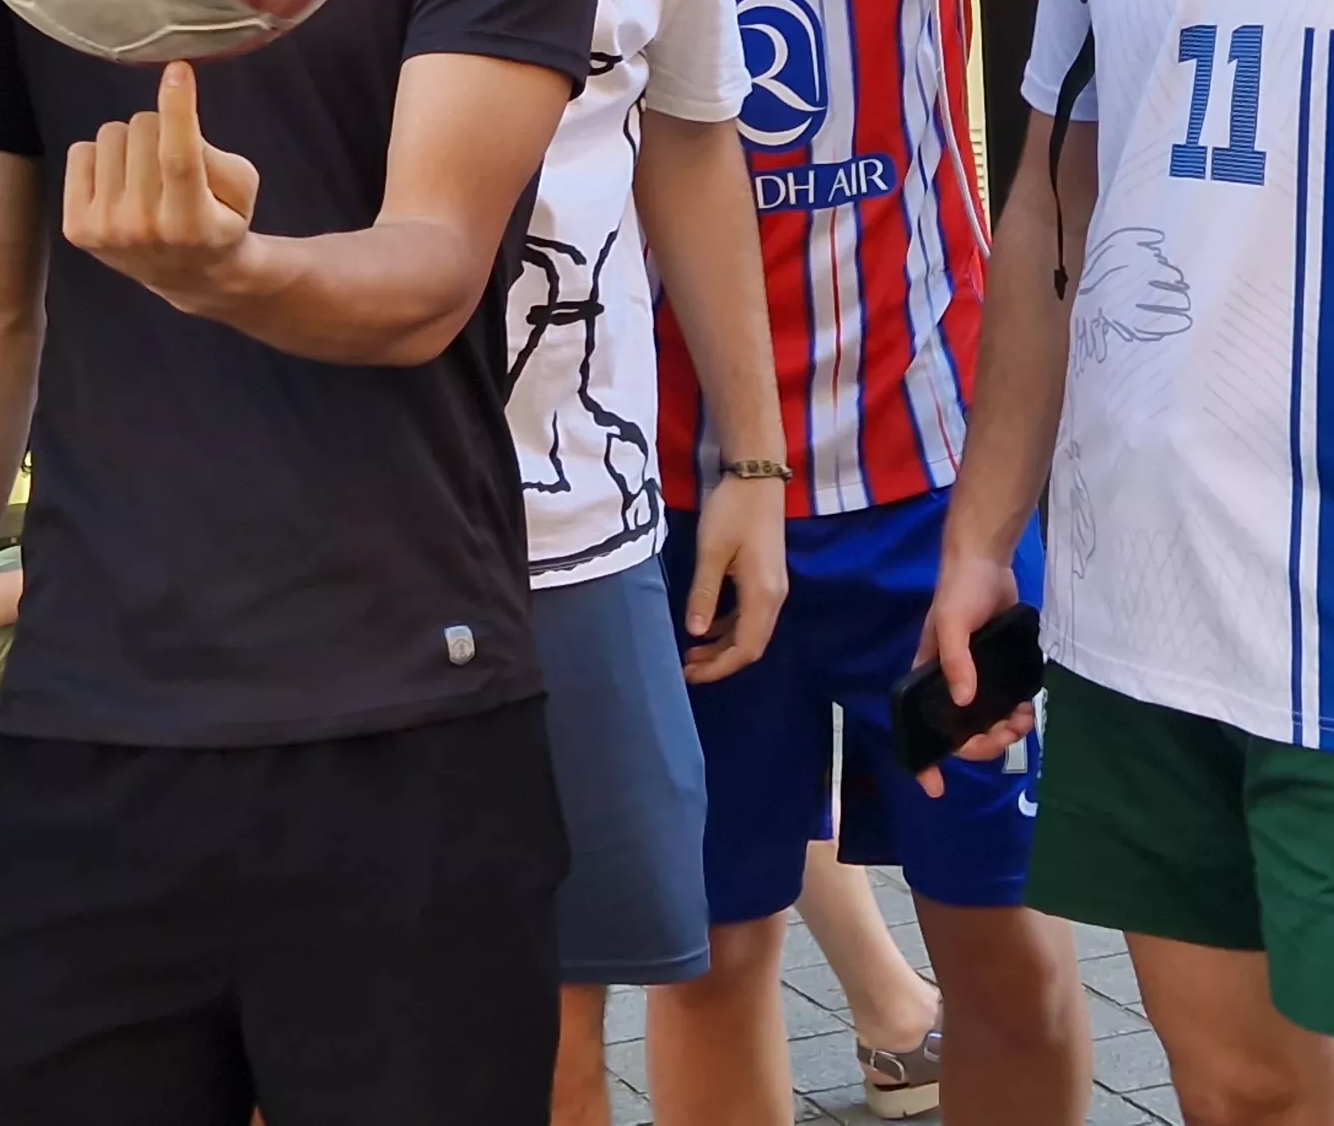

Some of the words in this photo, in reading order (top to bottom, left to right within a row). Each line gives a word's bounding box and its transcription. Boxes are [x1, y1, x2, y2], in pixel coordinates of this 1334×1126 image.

[1168, 24, 1267, 187] 11
[754, 169, 816, 210] DH
[827, 157, 890, 203] AIR
